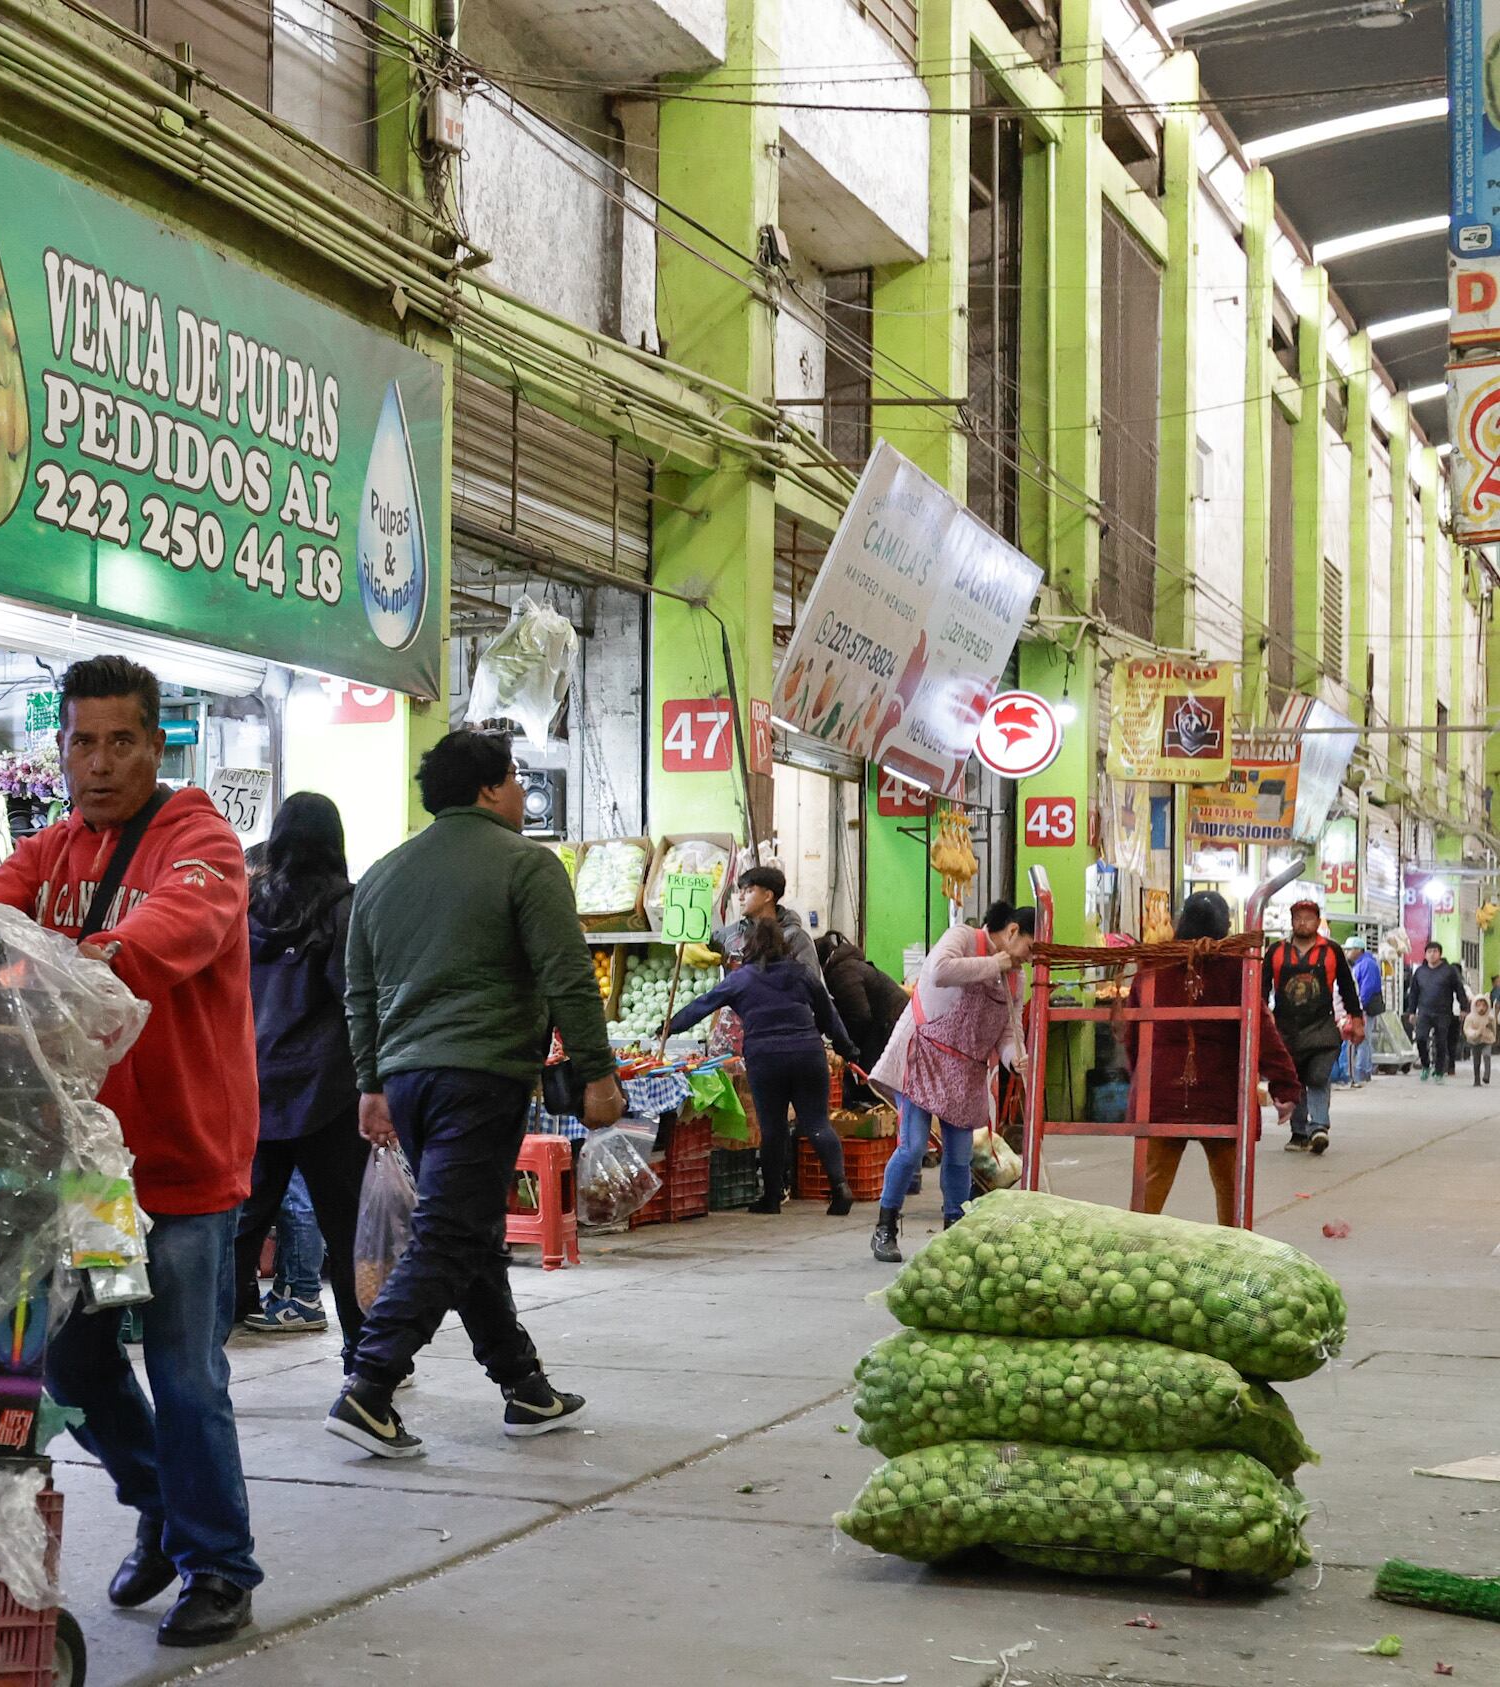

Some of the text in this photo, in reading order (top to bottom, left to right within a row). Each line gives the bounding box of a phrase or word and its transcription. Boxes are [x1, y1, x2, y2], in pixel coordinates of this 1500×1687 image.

[42, 246, 340, 464] VENTA DE PULPAS
[42, 369, 340, 540] PEDIDOS AL
[34, 460, 343, 607] 222 250 44 18
[370, 487, 411, 537] Pulpas
[385, 541, 397, 577] &
[863, 520, 934, 587] CAMILA'S
[844, 564, 878, 599] MAYOREO
[828, 621, 900, 680] 221-577-8824
[663, 711, 730, 760] 47
[219, 769, 268, 787] AGUACATE
[1026, 804, 1075, 839] 43
[668, 874, 709, 888] FRESAS
[1321, 862, 1357, 894] 35
[666, 887, 708, 941] 55
